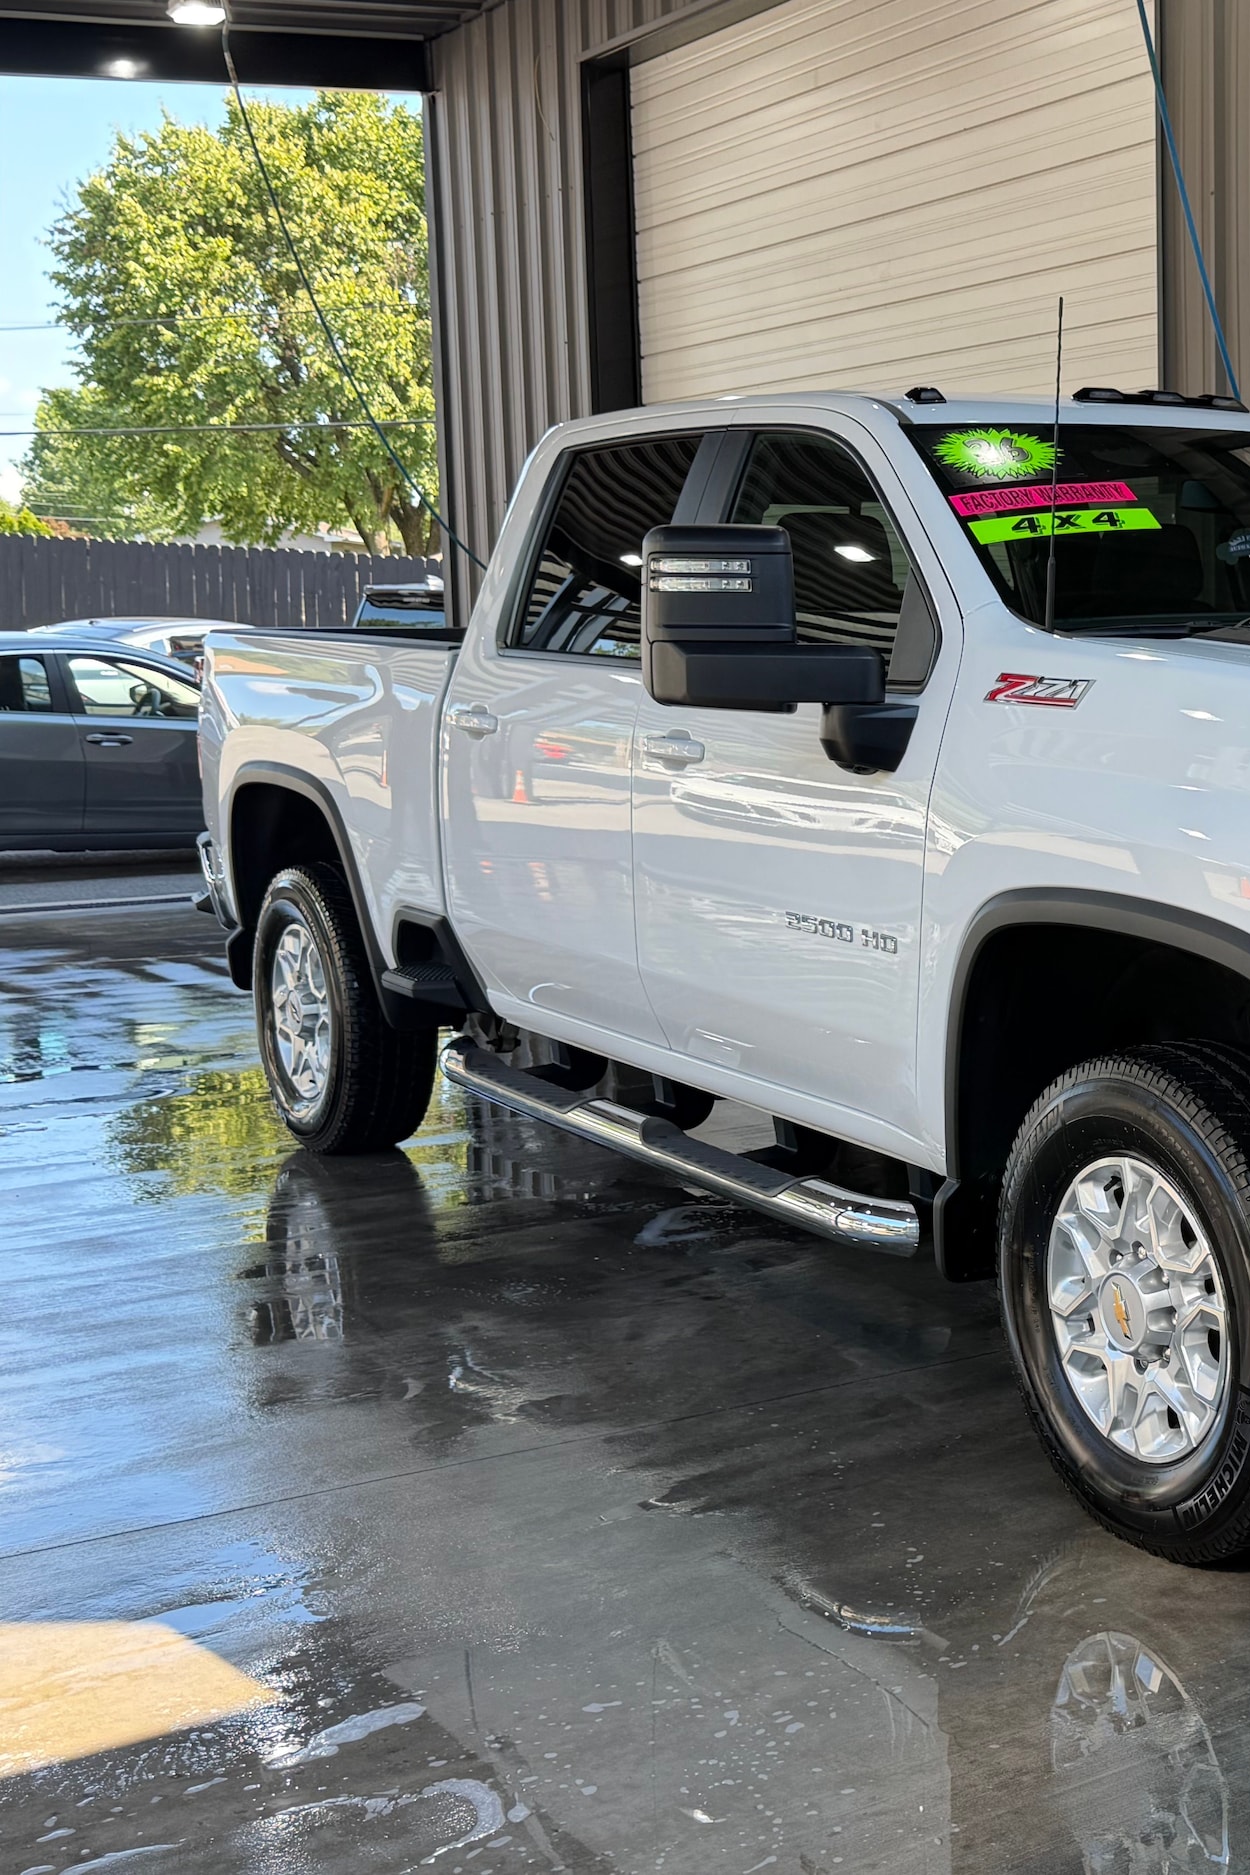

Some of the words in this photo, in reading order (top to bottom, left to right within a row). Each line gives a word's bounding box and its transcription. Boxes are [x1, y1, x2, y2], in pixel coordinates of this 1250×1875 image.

[959, 487, 1032, 512] FACTORY
[1033, 483, 1123, 504] WARRANTY
[983, 672, 1097, 711] Z71
[785, 910, 853, 943] 2500
[861, 928, 898, 954] HD
[1182, 1428, 1248, 1527] MICHELIN
